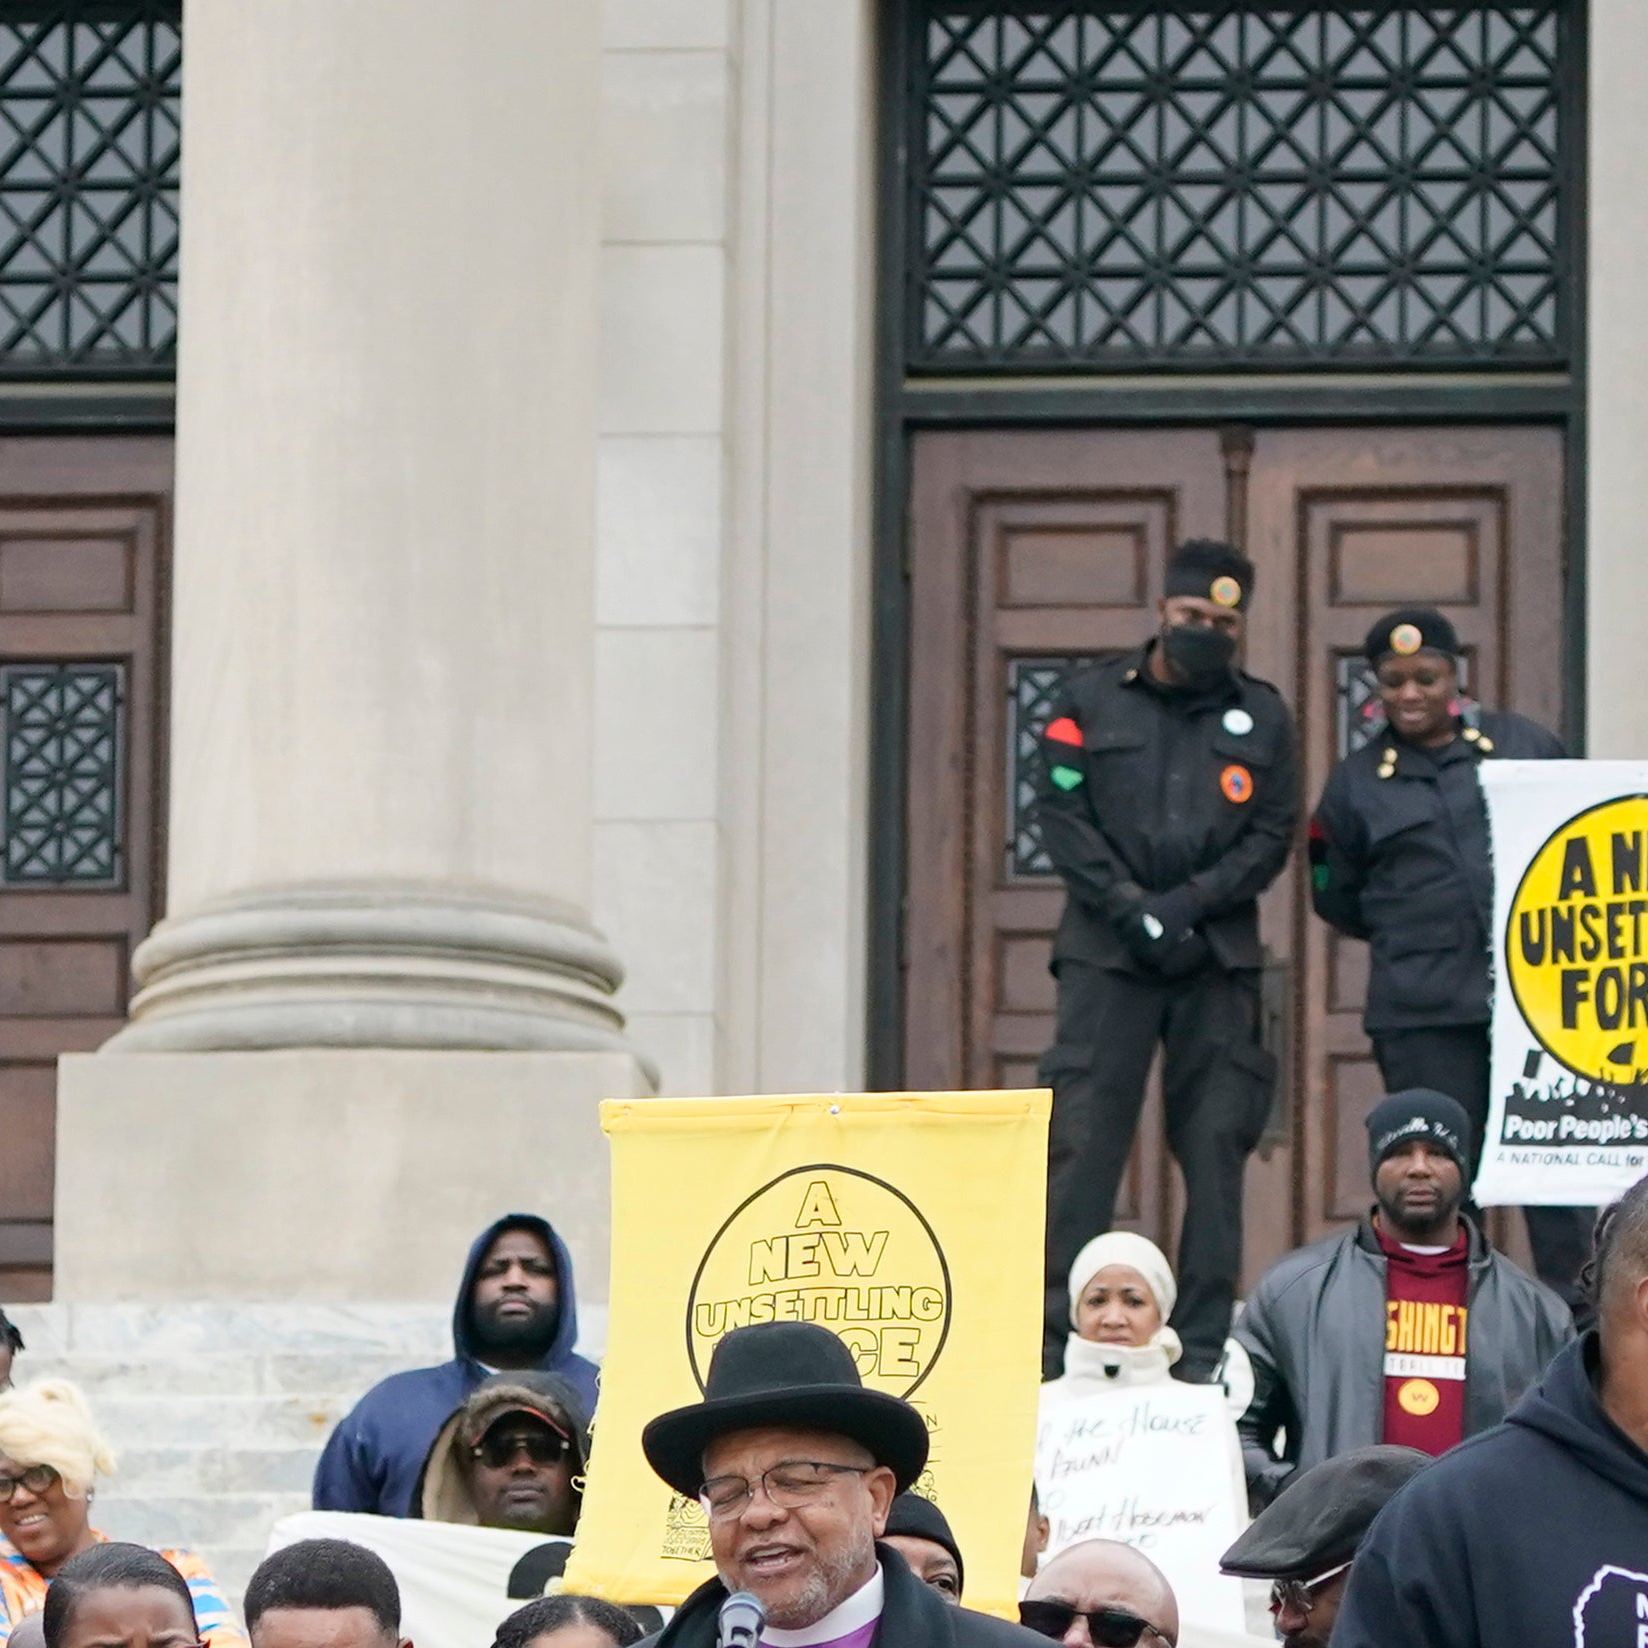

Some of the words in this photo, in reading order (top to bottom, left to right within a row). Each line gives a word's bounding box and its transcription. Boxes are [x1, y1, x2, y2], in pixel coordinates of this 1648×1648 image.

[1559, 836, 1597, 900] A
[1504, 1114, 1557, 1140] Poor
[1559, 1113, 1648, 1144] People's
[1510, 1152, 1580, 1166] NATIONAL
[1587, 1153, 1621, 1167] CALL
[795, 1181, 842, 1228] A
[749, 1231, 889, 1285] NEW
[695, 1286, 943, 1337] UNSETTLING
